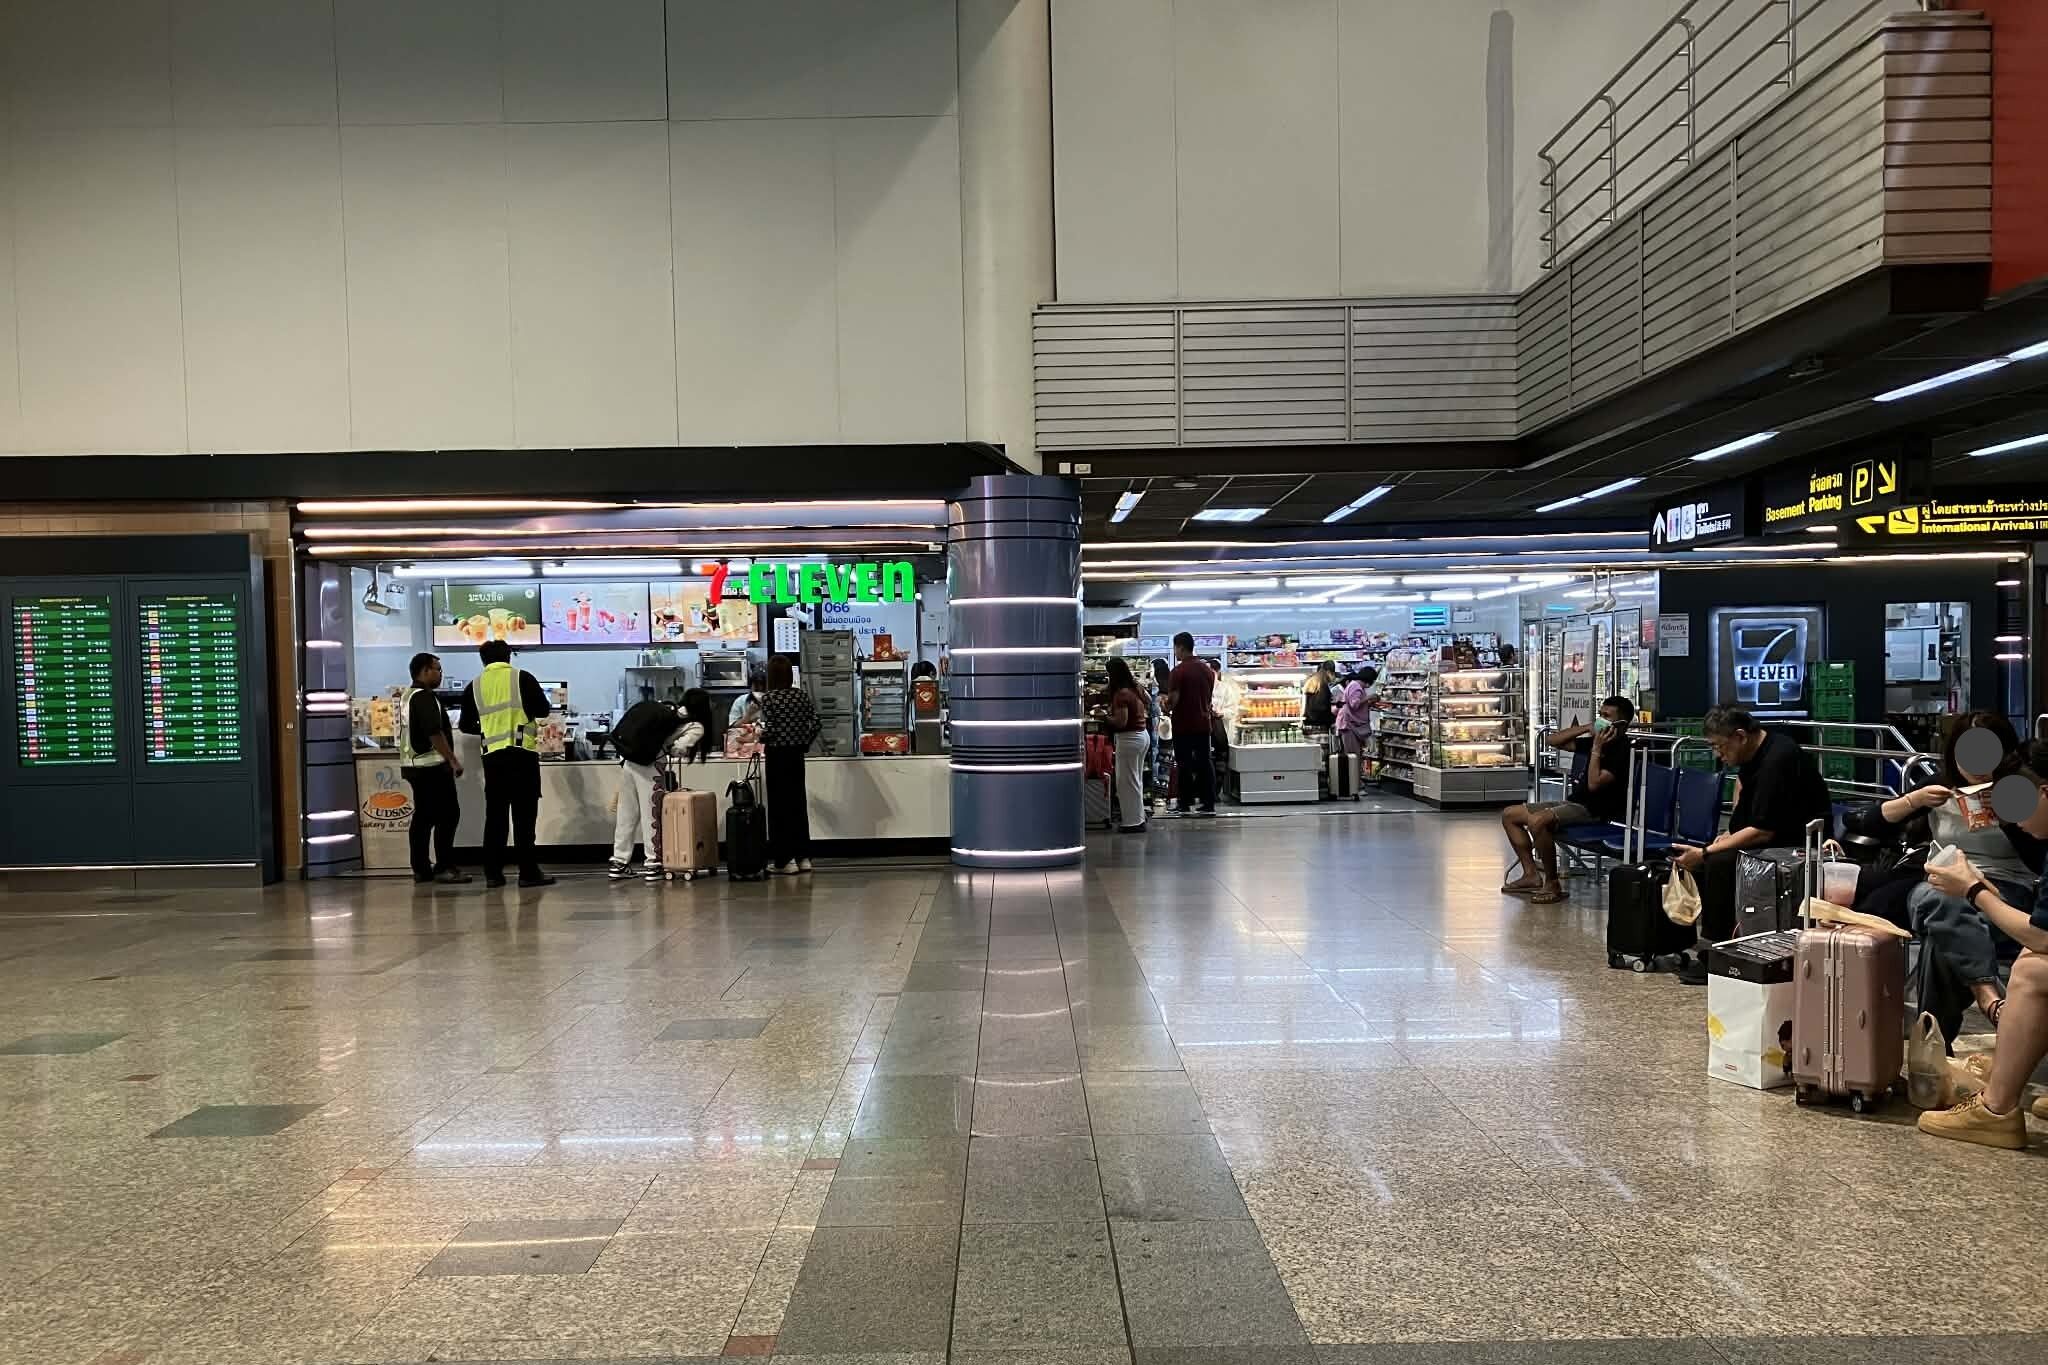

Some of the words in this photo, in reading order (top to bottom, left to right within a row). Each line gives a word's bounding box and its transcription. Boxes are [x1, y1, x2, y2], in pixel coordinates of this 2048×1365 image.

[1855, 467, 1869, 499] P
[1765, 500, 1806, 523] Basement
[1808, 493, 1843, 513] Parking
[1922, 521, 1991, 534] International
[1991, 520, 2034, 532] Arrivals
